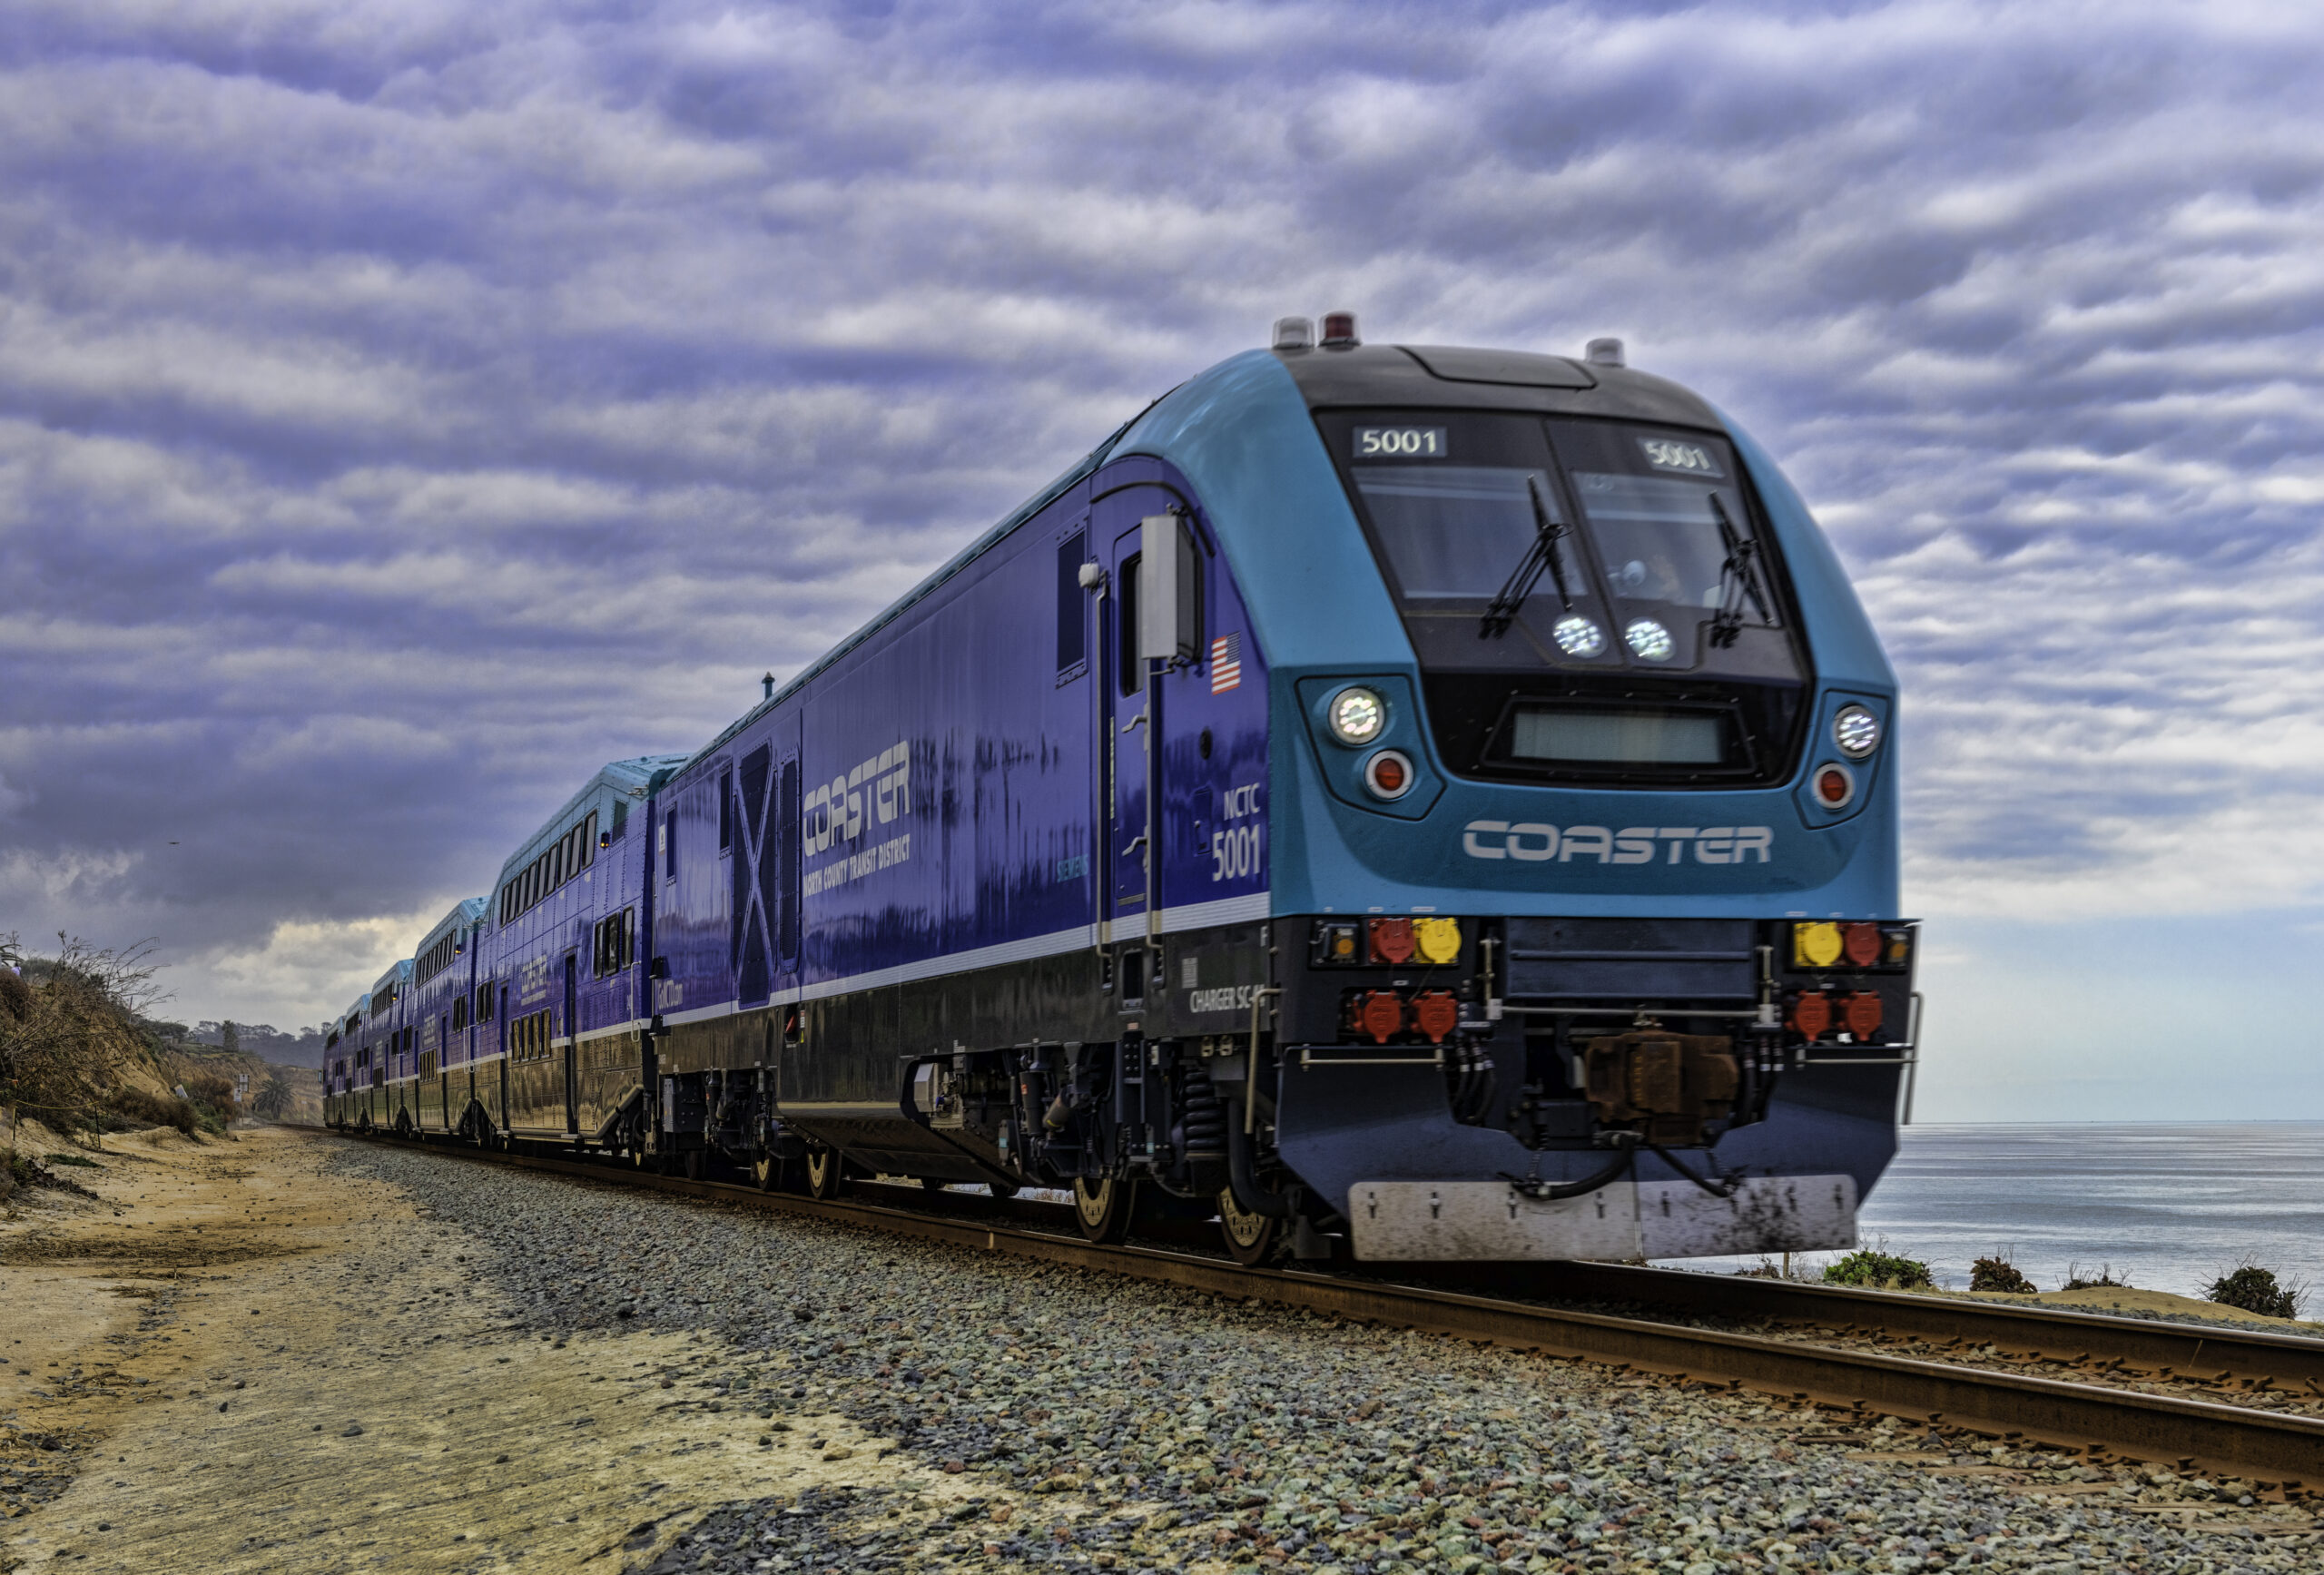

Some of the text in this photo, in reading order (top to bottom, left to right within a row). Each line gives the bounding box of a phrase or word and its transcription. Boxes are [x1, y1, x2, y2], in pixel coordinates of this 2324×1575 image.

[1363, 428, 1436, 453] 5001
[1644, 440, 1710, 470] 5001
[803, 740, 910, 856] COASTER
[1224, 783, 1260, 821] NCTC
[1212, 823, 1260, 881] 5001
[1462, 820, 1774, 864] COASTER
[803, 833, 910, 898] NORTH COUNTY TRANSIT DISTRICT
[1057, 853, 1088, 882] SIEMENS
[1190, 987, 1236, 1013] CHARGER
